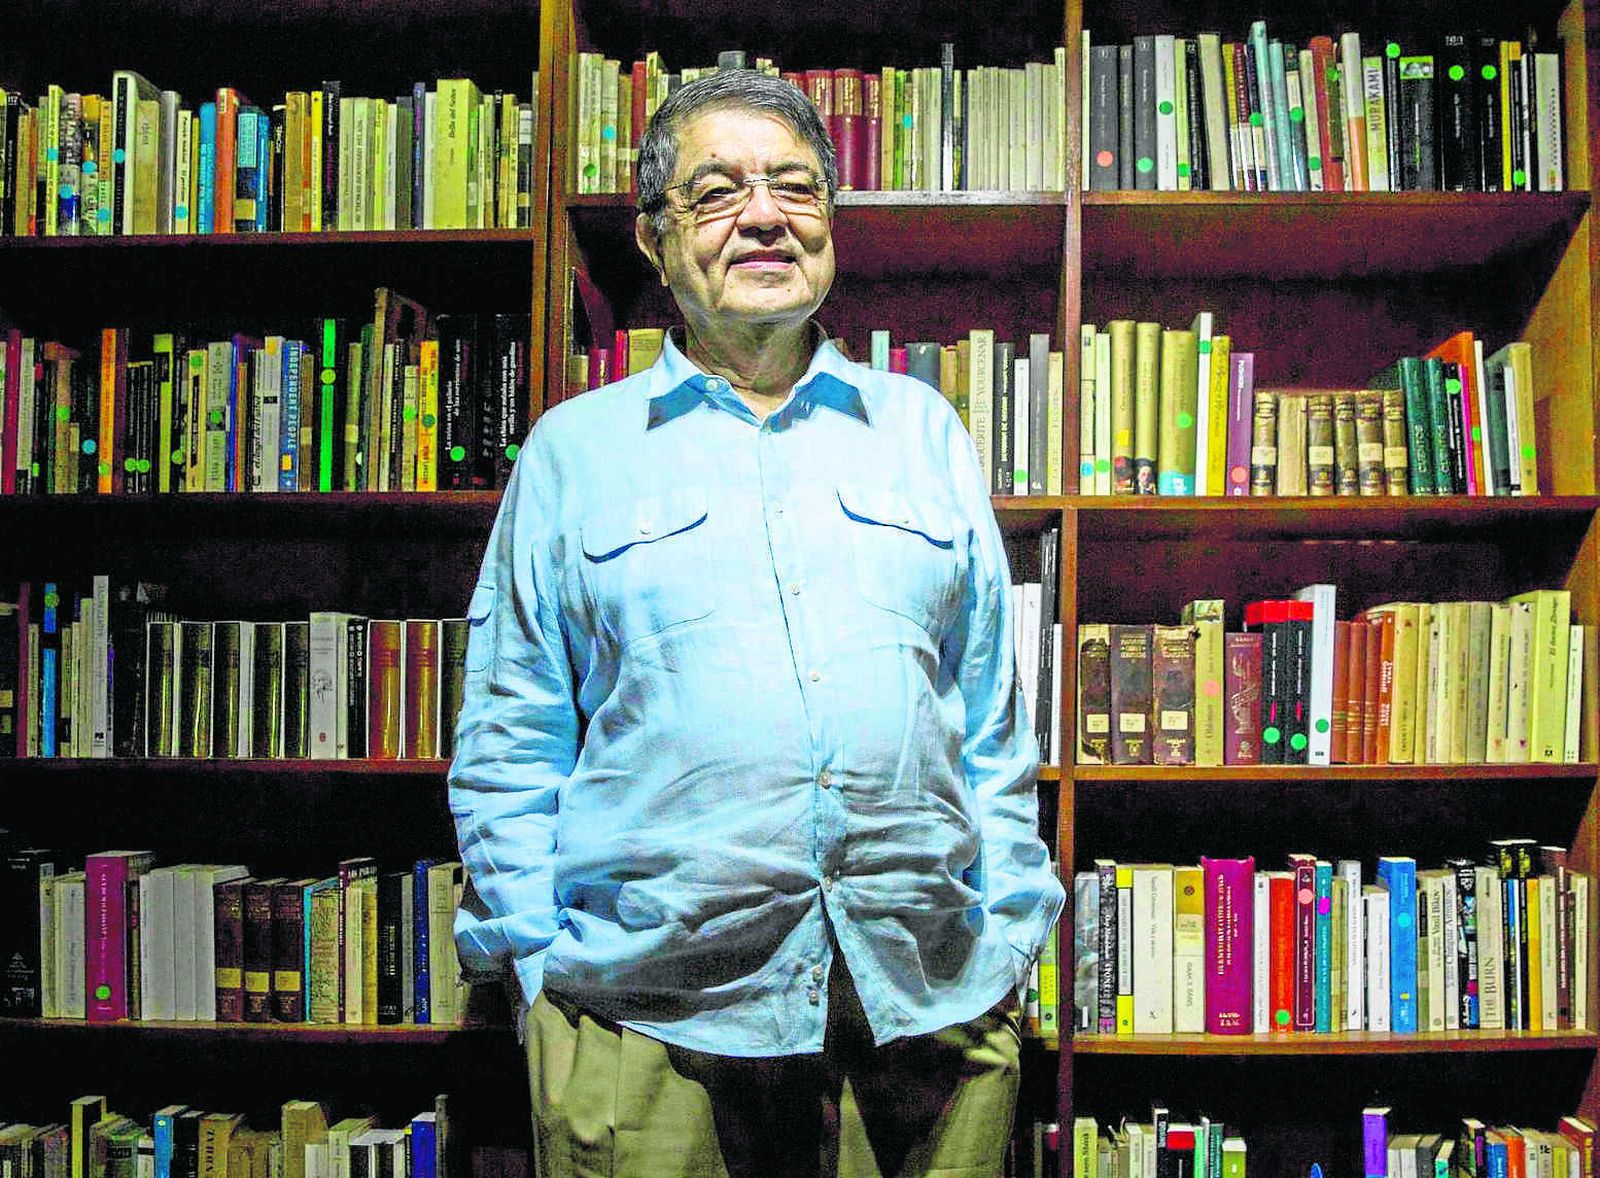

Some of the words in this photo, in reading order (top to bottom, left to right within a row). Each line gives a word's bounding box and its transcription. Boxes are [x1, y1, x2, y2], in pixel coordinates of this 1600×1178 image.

[1368, 68, 1383, 132] MURAKAMI
[288, 346, 299, 412] INDEPENDENT
[975, 337, 986, 395] YOURCENAR
[288, 415, 299, 449] PEOPLE
[1414, 424, 1427, 473] CUENTOS
[1484, 957, 1497, 994] BURN
[1484, 997, 1497, 1017] THE
[204, 1128, 215, 1178] NDHAL
